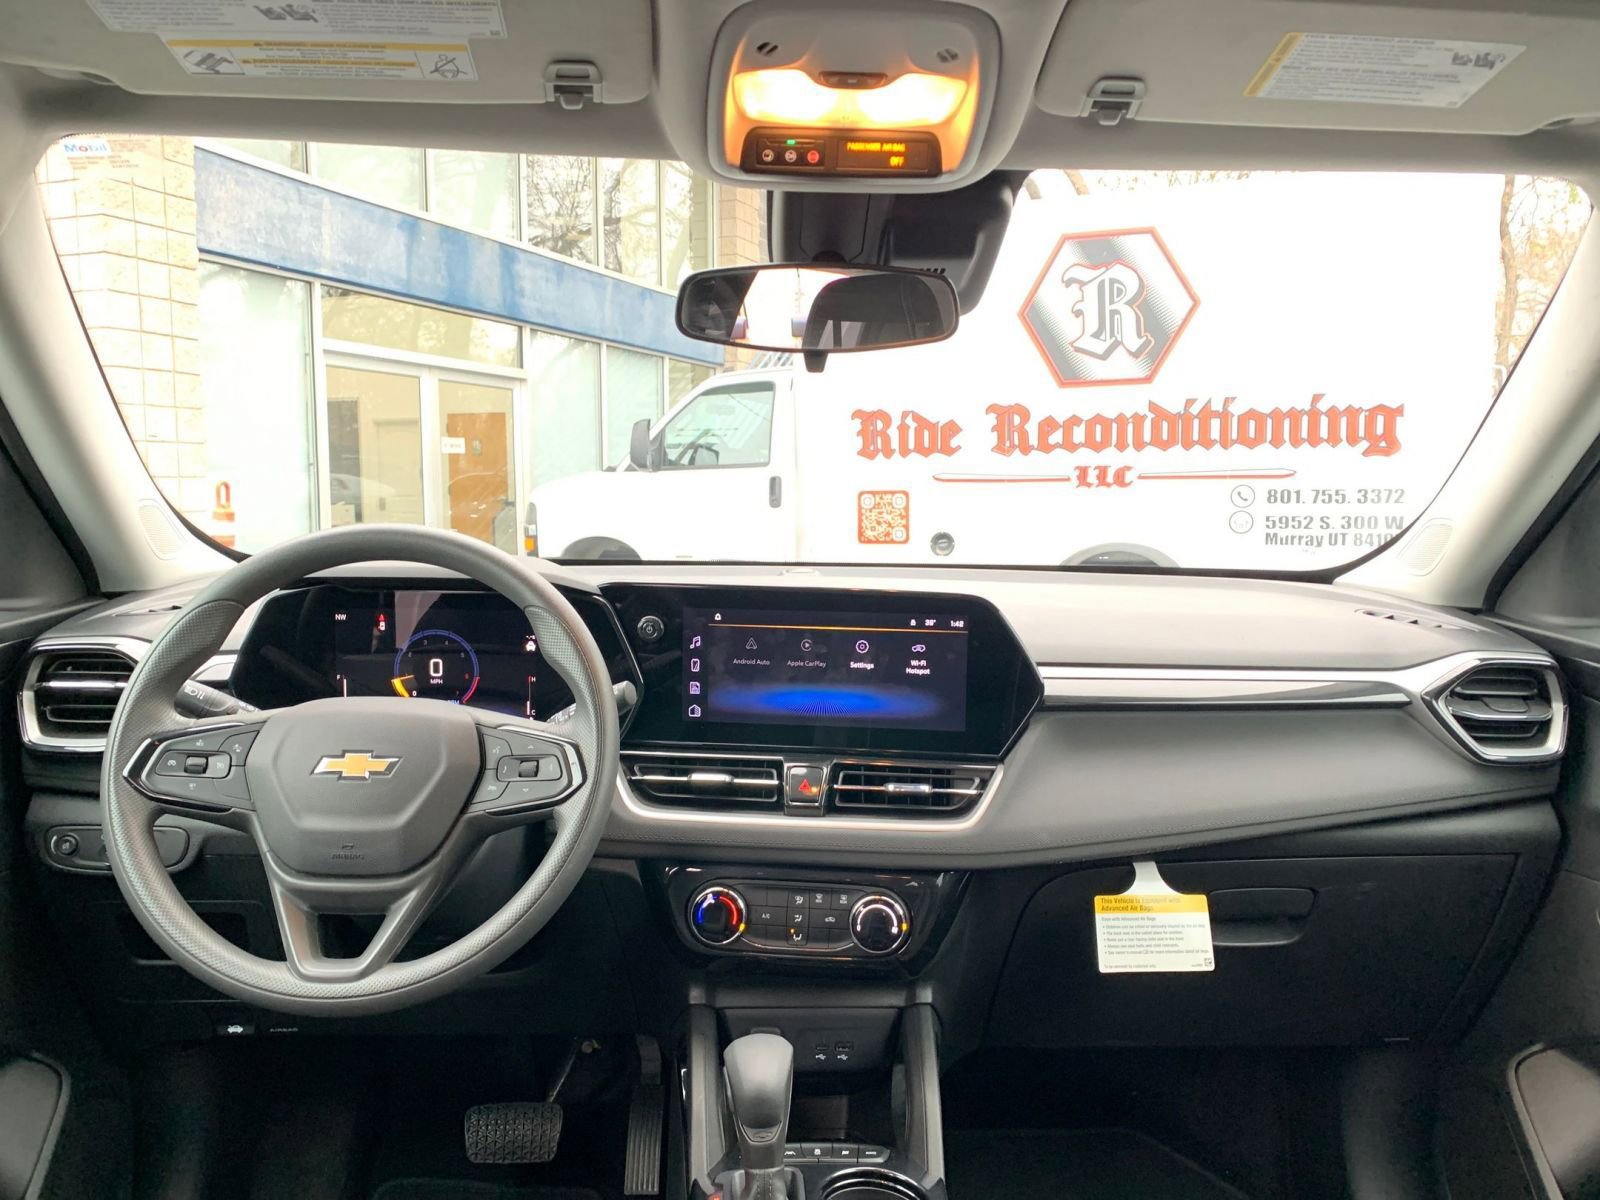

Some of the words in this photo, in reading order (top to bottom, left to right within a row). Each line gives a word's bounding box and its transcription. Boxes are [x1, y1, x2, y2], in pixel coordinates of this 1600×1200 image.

[63, 142, 108, 153] Mobil
[889, 156, 905, 167] OFF
[1061, 260, 1155, 361] R
[851, 408, 964, 460] Ride
[985, 393, 1405, 458] Reconditioning
[1073, 465, 1137, 488] LLC
[1357, 488, 1406, 505] 3372
[1265, 515, 1314, 530] 5952
[1319, 515, 1335, 530] S.
[1340, 515, 1378, 530] 300
[1385, 515, 1404, 530] W
[1265, 532, 1324, 547] Murray
[1328, 533, 1349, 546] UT
[335, 613, 348, 621] NW
[950, 620, 965, 628] 1:42
[733, 658, 755, 666] Android
[787, 659, 803, 668] Apple
[805, 660, 827, 669] CarPlay
[850, 661, 875, 671] Settings
[910, 659, 927, 667] Wi-Fi
[429, 658, 443, 678] 0
[906, 667, 931, 676] Hotspot
[1101, 897, 1113, 905] This
[1114, 897, 1135, 905] Vehicle
[1101, 904, 1129, 912] Advanced
